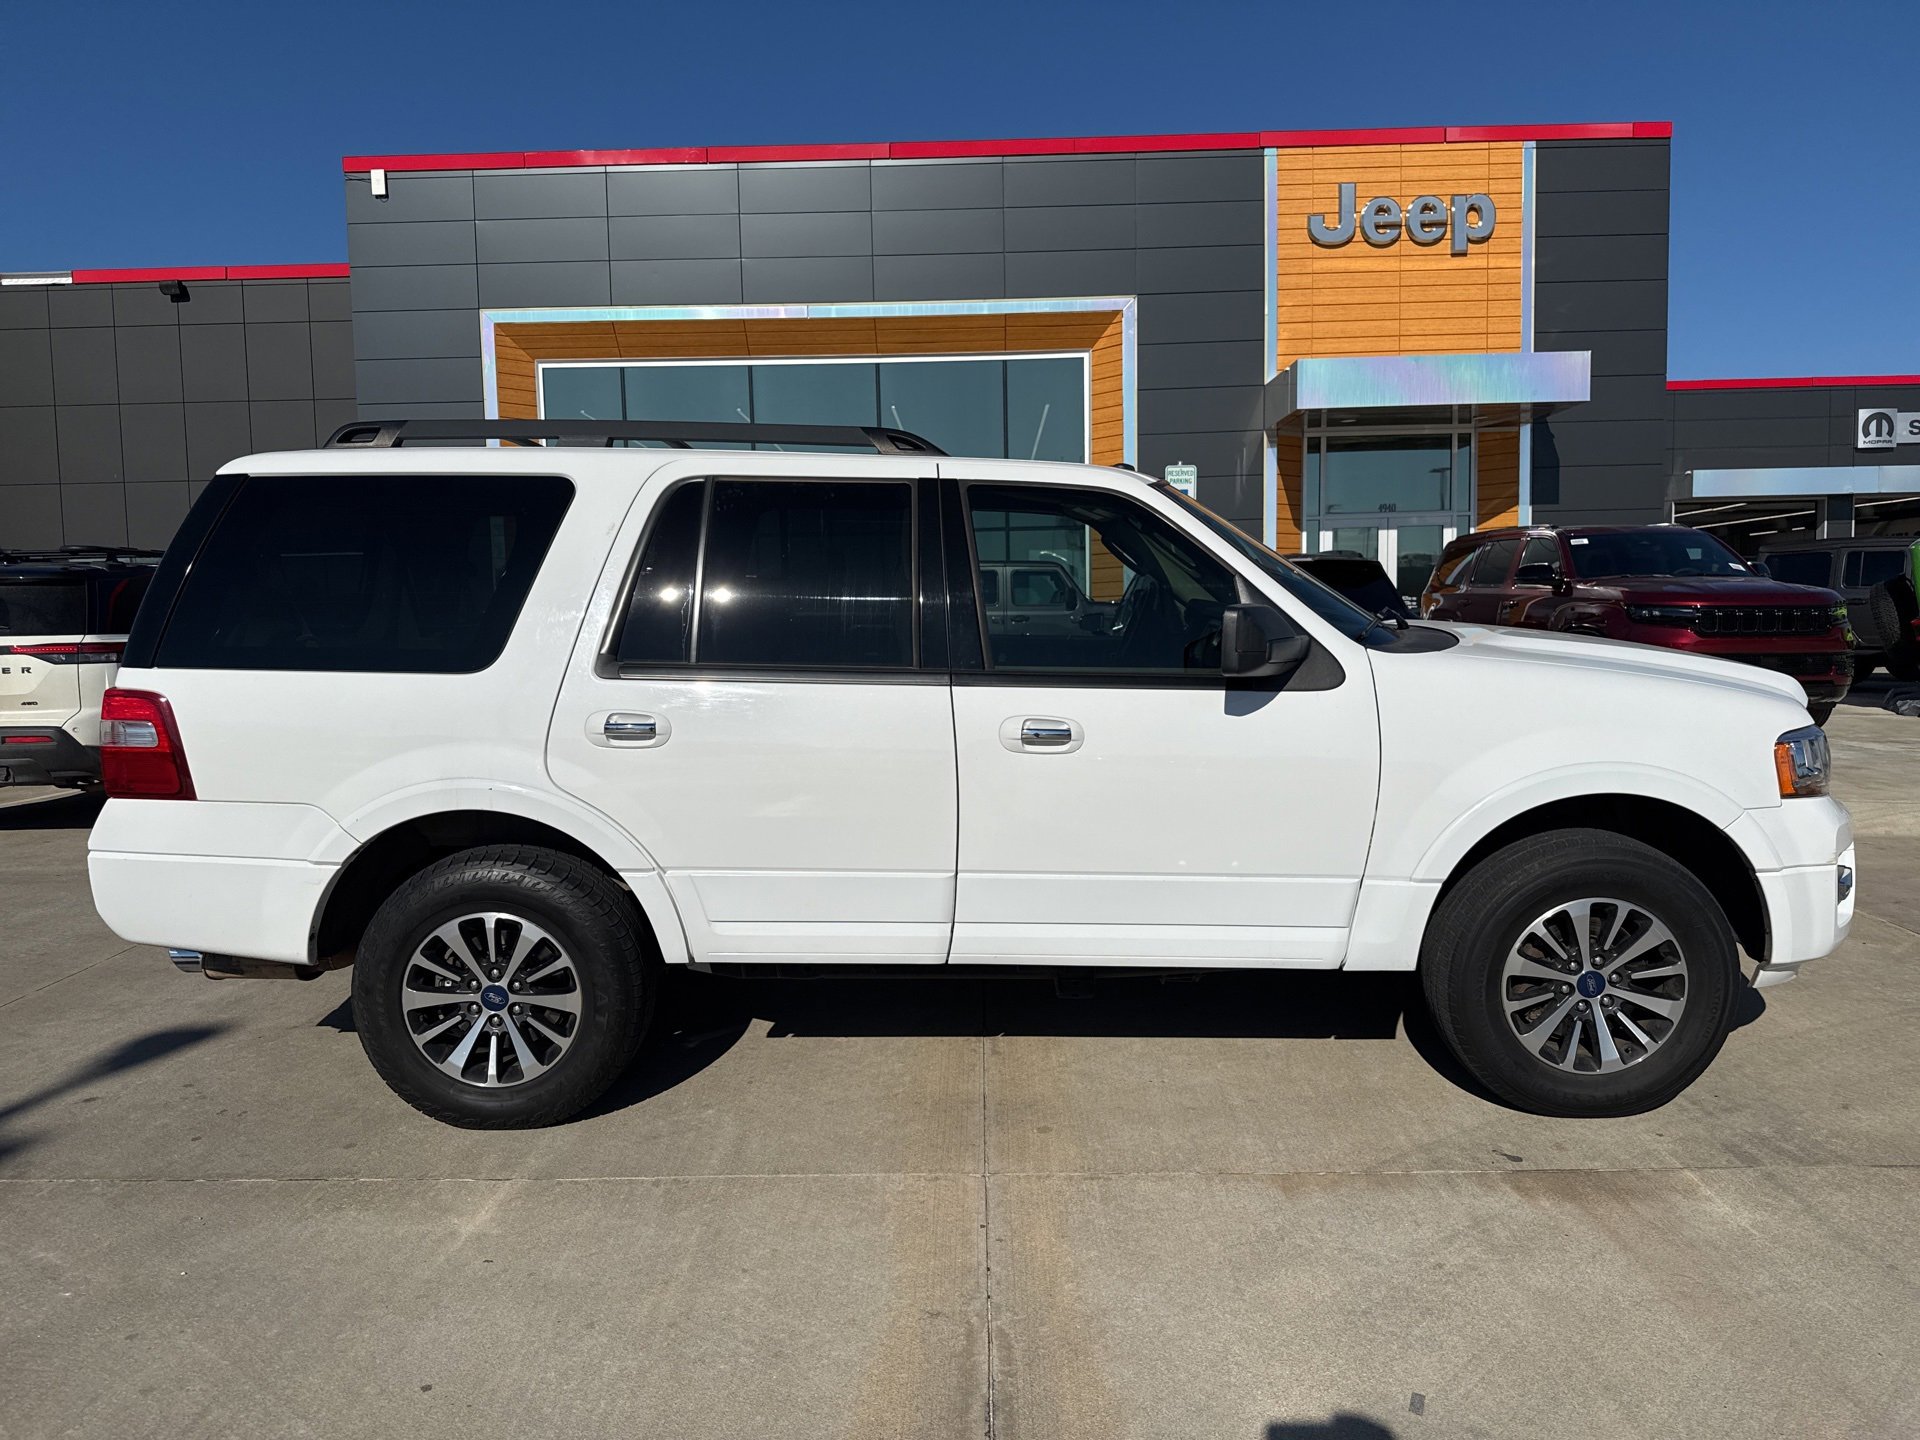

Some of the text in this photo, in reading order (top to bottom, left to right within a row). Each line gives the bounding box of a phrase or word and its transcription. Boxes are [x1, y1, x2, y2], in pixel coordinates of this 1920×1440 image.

[1307, 182, 1496, 257] Jeep
[1167, 469, 1194, 477] RESERVED
[1377, 503, 1397, 513] 4940
